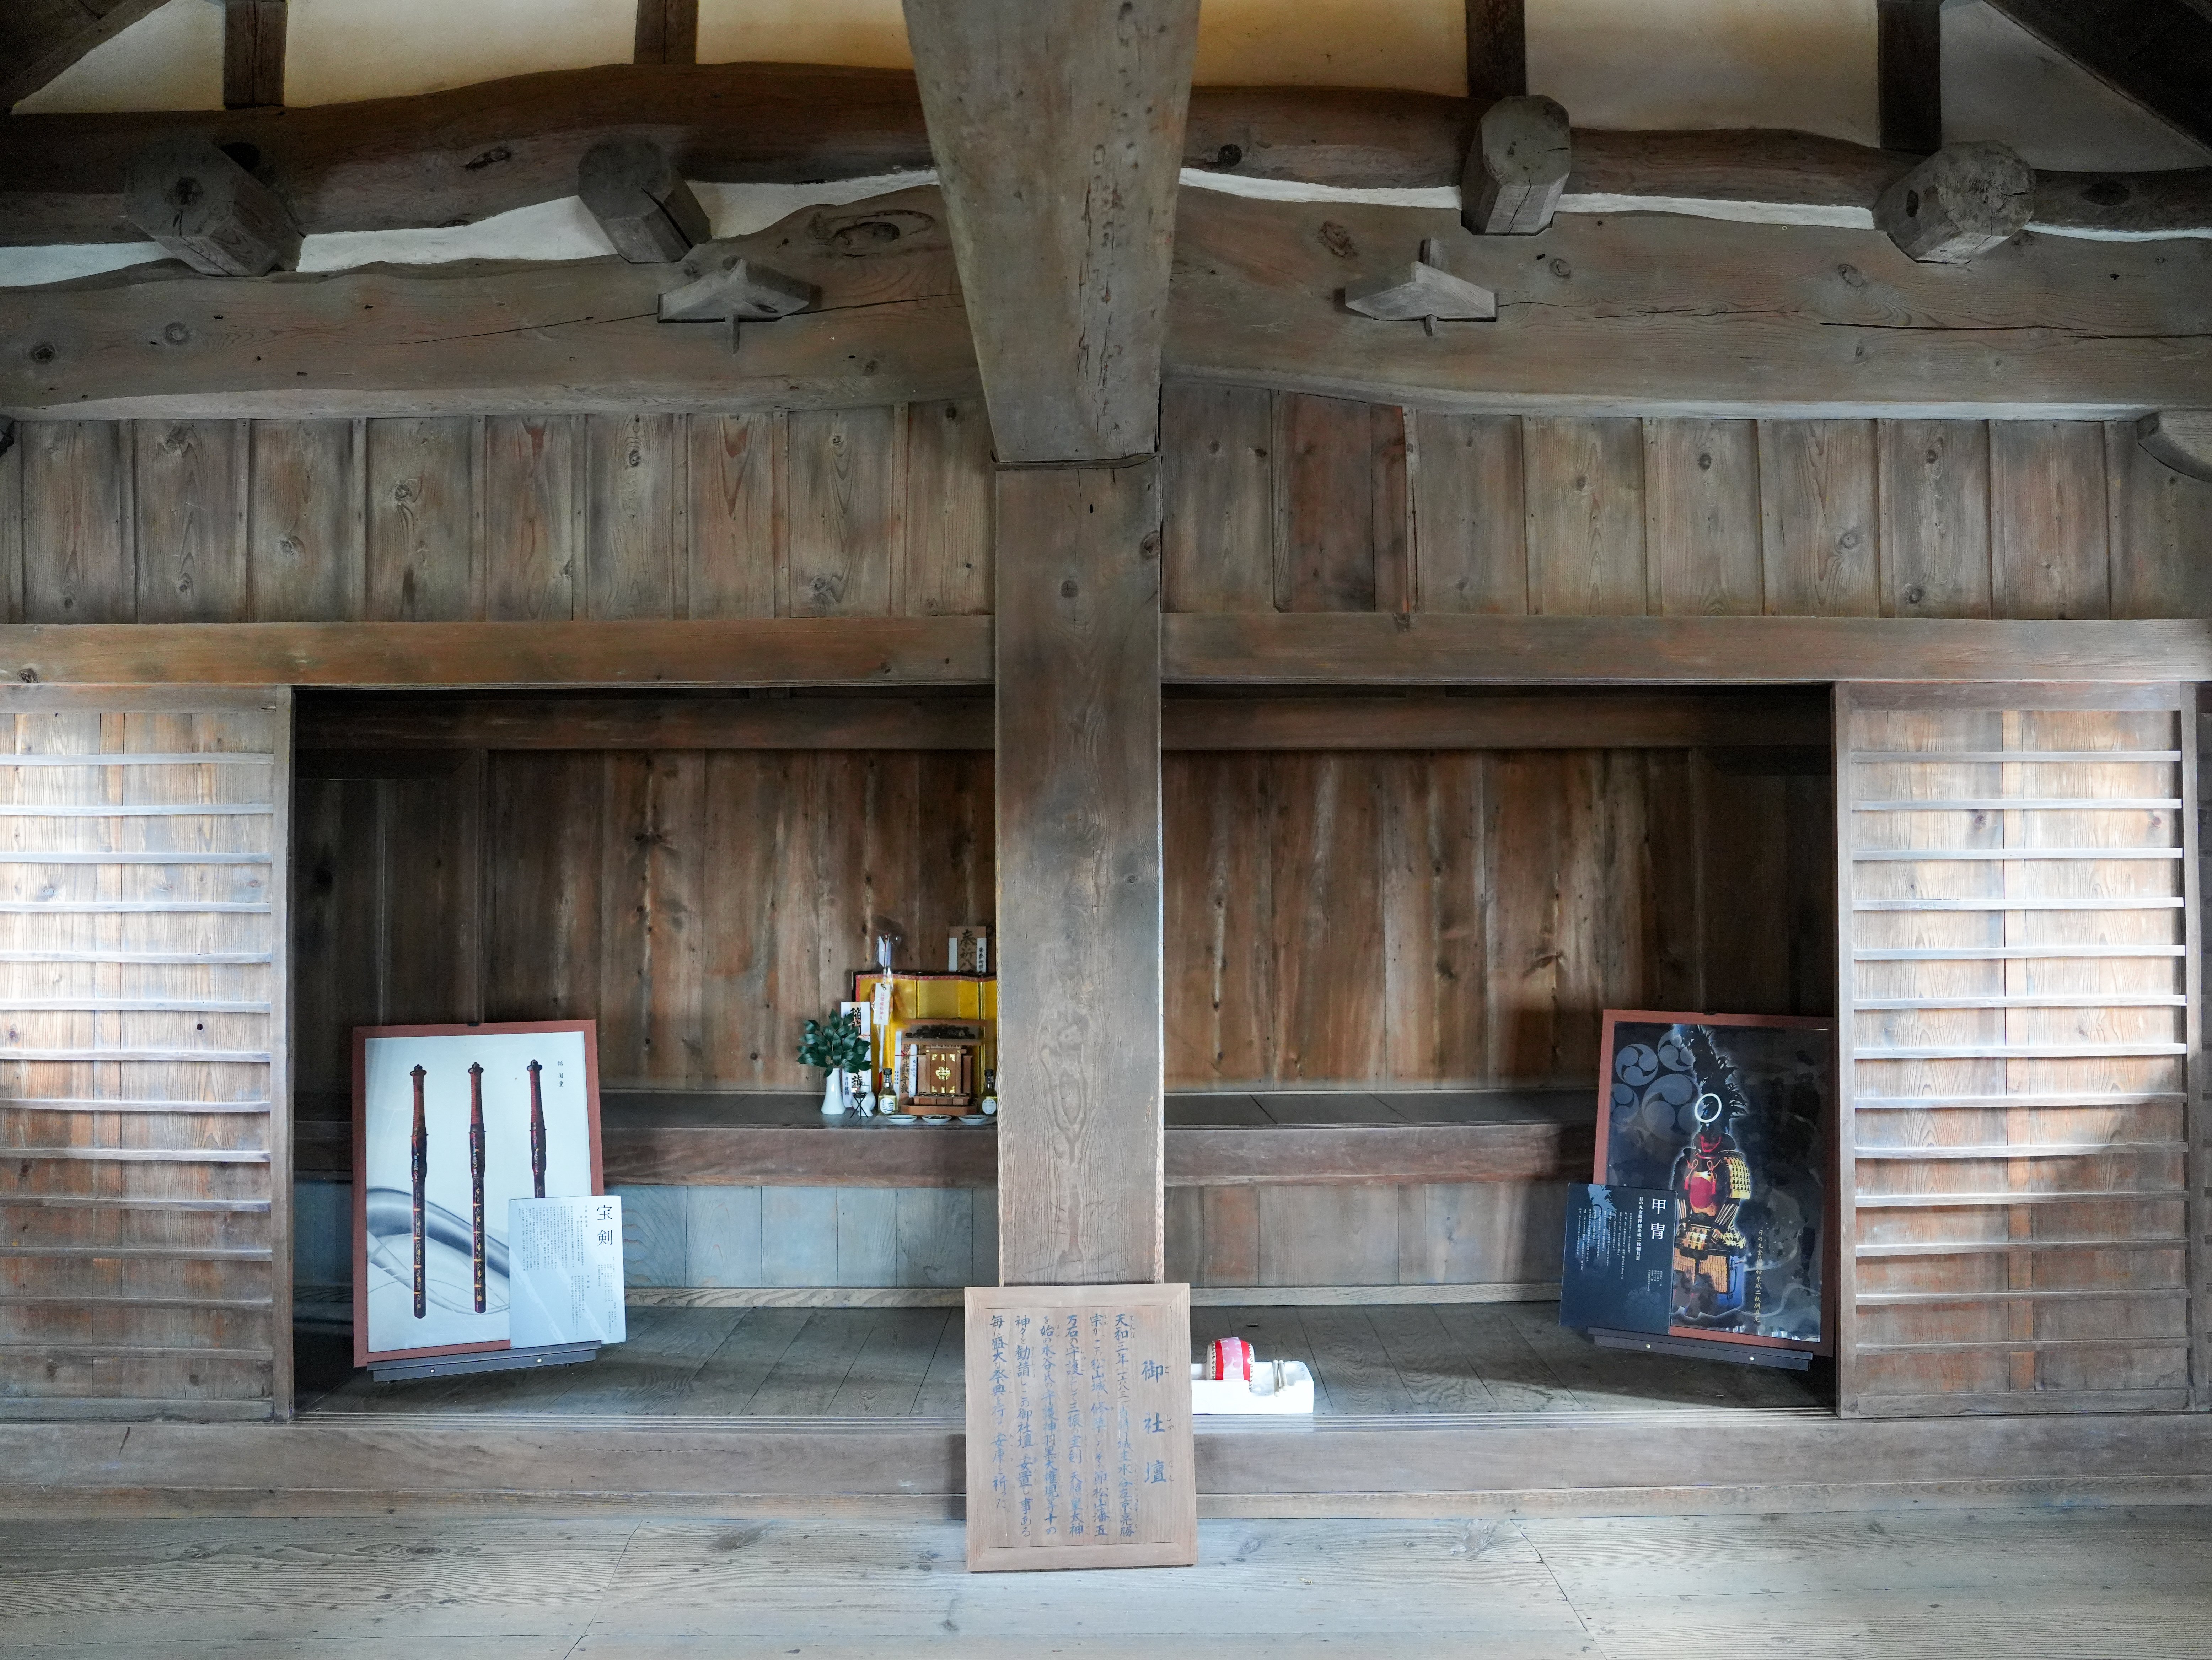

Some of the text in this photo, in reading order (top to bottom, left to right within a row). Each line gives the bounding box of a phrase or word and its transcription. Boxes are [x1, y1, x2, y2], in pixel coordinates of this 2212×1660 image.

[597, 1205, 613, 1246] 宝剣
[1651, 1198, 1666, 1240] 甲冑
[1141, 1360, 1166, 1484] 御社壇
